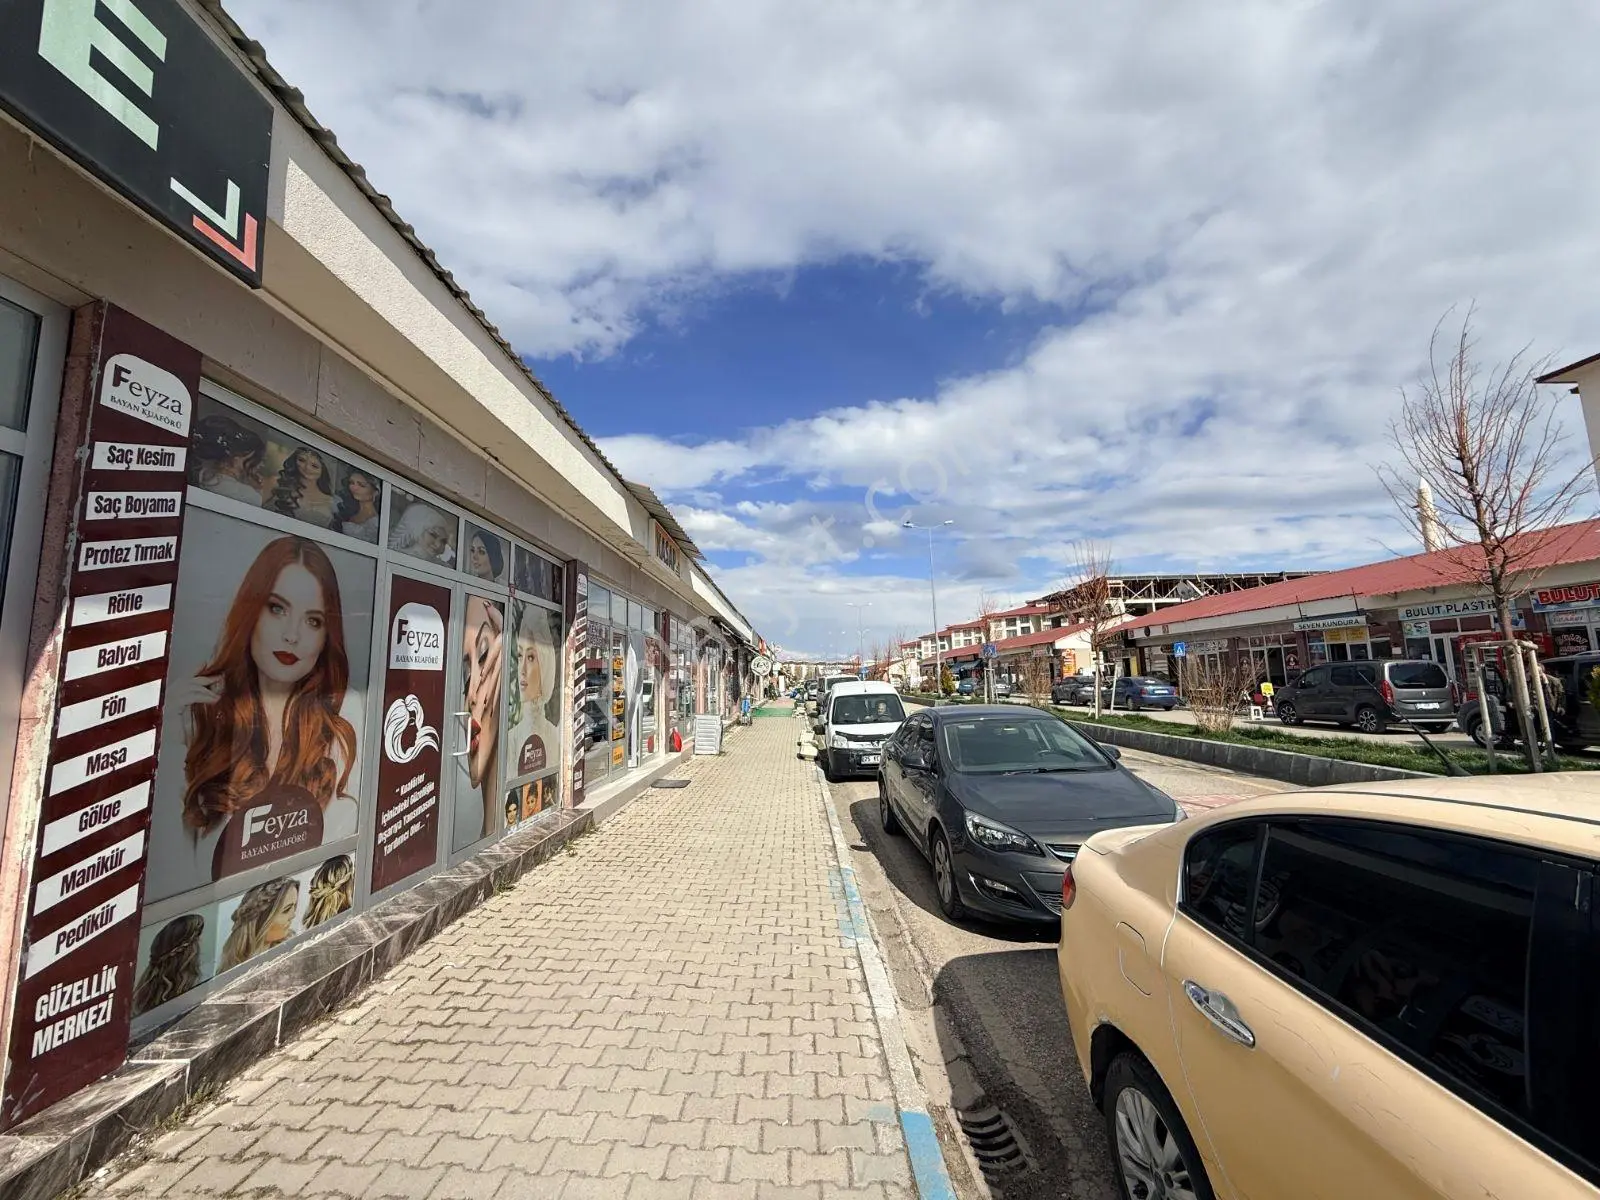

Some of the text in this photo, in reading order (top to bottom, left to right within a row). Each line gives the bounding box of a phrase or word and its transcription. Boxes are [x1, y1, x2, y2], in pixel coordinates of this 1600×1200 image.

[112, 363, 183, 416] Feyza
[110, 395, 182, 430] BAYAN KUAFÖRÜ
[107, 444, 176, 470] Saç Kesim
[94, 495, 176, 518] Saç Boyama
[83, 542, 174, 566] Protez Tırnak
[107, 592, 143, 615] Röfle
[1538, 583, 1600, 604] BULUT
[1298, 618, 1360, 630] SEVEN KUNDURA
[1405, 605, 1442, 618] BULUT
[397, 618, 439, 654] Feyza
[97, 640, 142, 668] Balyaj
[395, 654, 413, 663] BAYAN
[100, 696, 127, 719] Fön
[85, 746, 128, 776] Maşa
[78, 799, 122, 833] Gölge
[241, 803, 308, 848] Feyza
[241, 843, 269, 860] BAYAN
[59, 847, 126, 897] Manikür
[55, 903, 117, 955] Pedikür
[34, 964, 119, 1023] GÜZELLİK
[31, 995, 113, 1060] MERKEZİ
